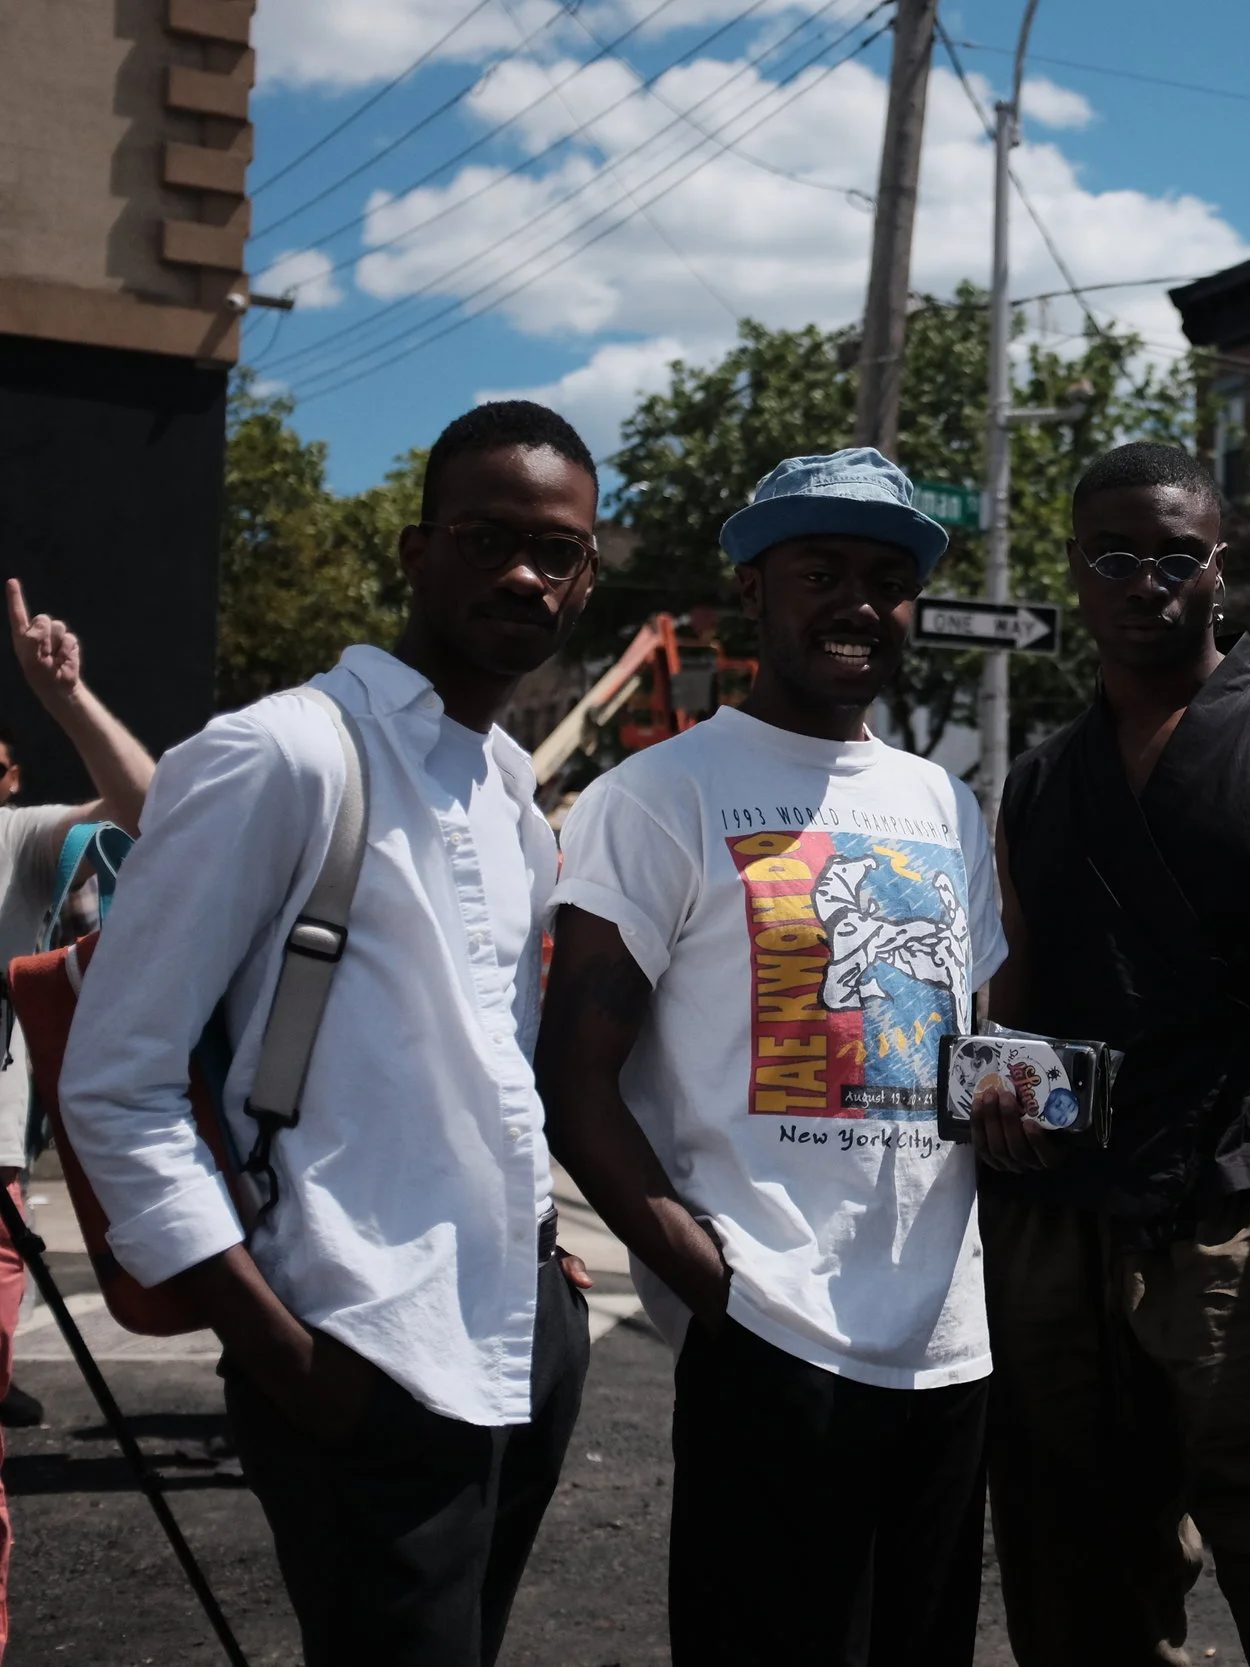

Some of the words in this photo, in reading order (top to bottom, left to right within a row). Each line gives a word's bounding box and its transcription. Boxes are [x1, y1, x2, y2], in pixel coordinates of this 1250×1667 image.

[934, 613, 974, 635] ONE
[994, 617, 1036, 639] WAY
[721, 807, 766, 830] 1993
[776, 806, 840, 826] WORLD
[851, 809, 959, 842] CHAMPIONSHIP
[845, 1090, 885, 1109] August
[779, 1124, 828, 1145] New
[838, 1127, 892, 1151] York
